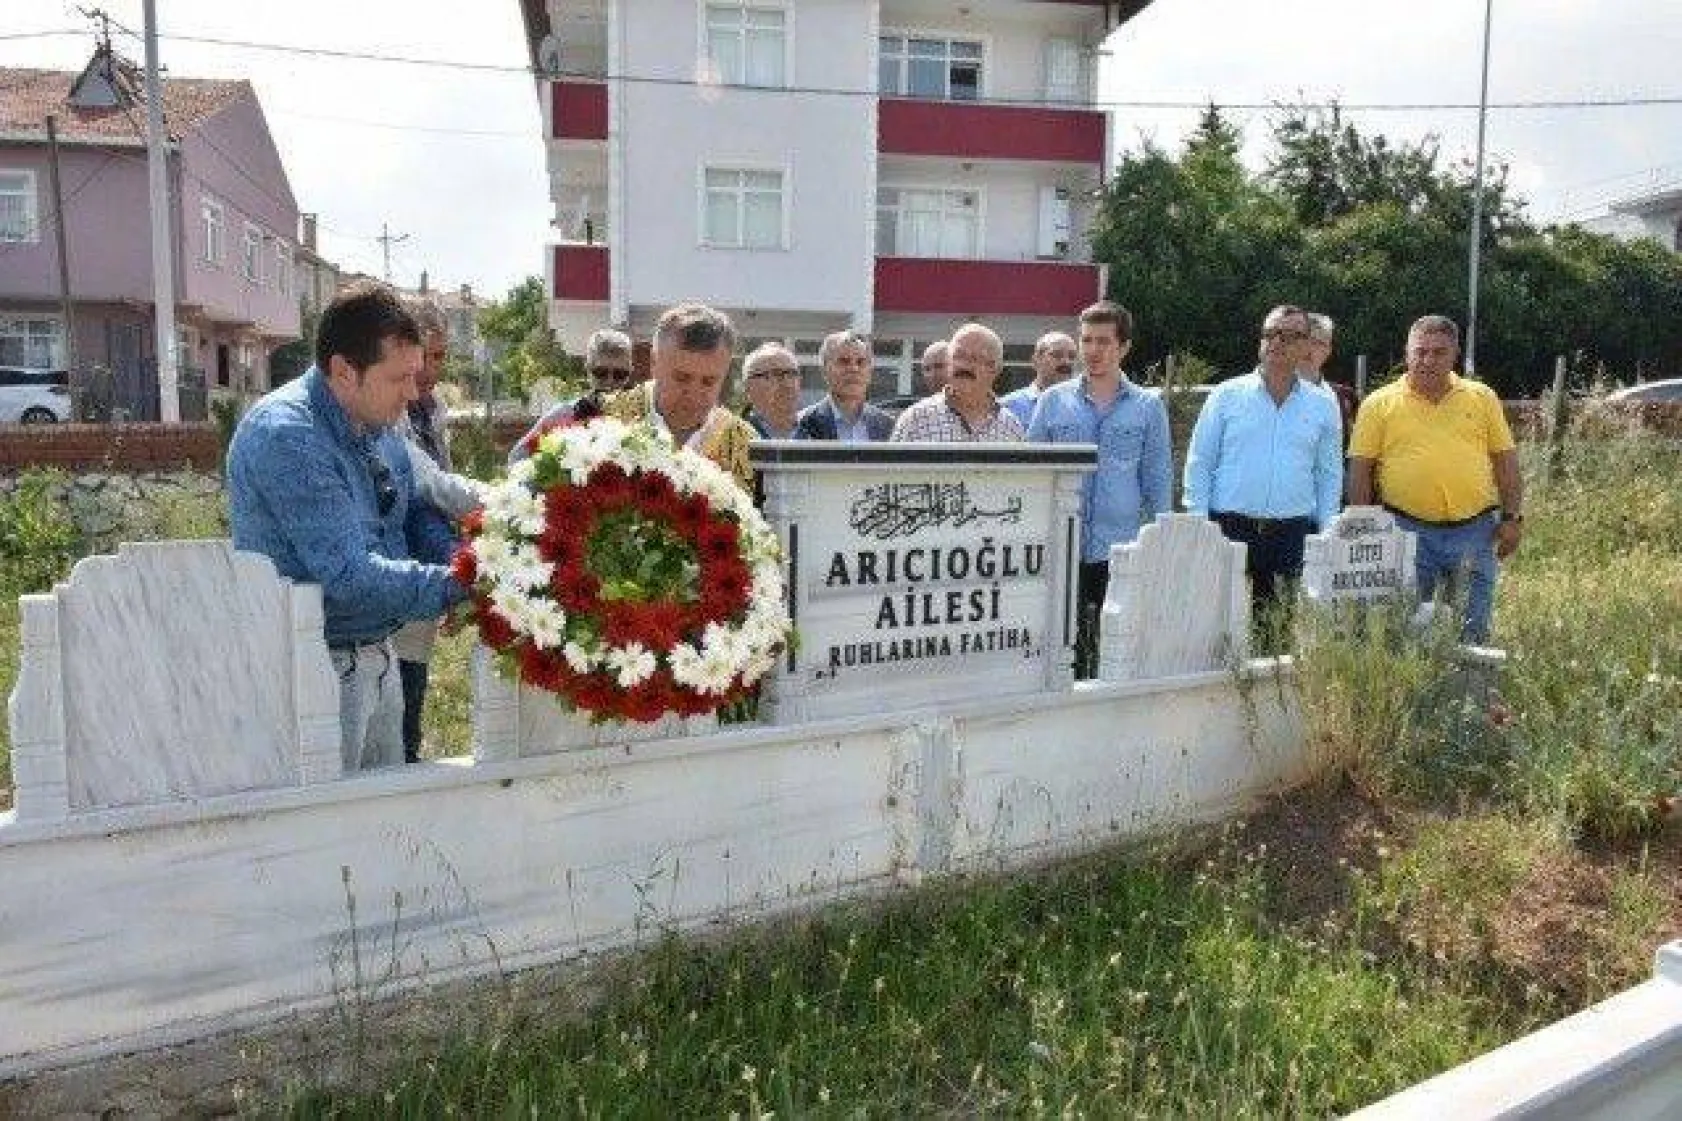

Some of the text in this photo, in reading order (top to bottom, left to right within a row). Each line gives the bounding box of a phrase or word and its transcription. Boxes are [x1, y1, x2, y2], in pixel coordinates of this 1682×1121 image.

[826, 538, 1044, 587] ARICIOĞLU
[876, 582, 1001, 630] AİLESİ
[829, 627, 1031, 667] RUHLARINA FATİHA
